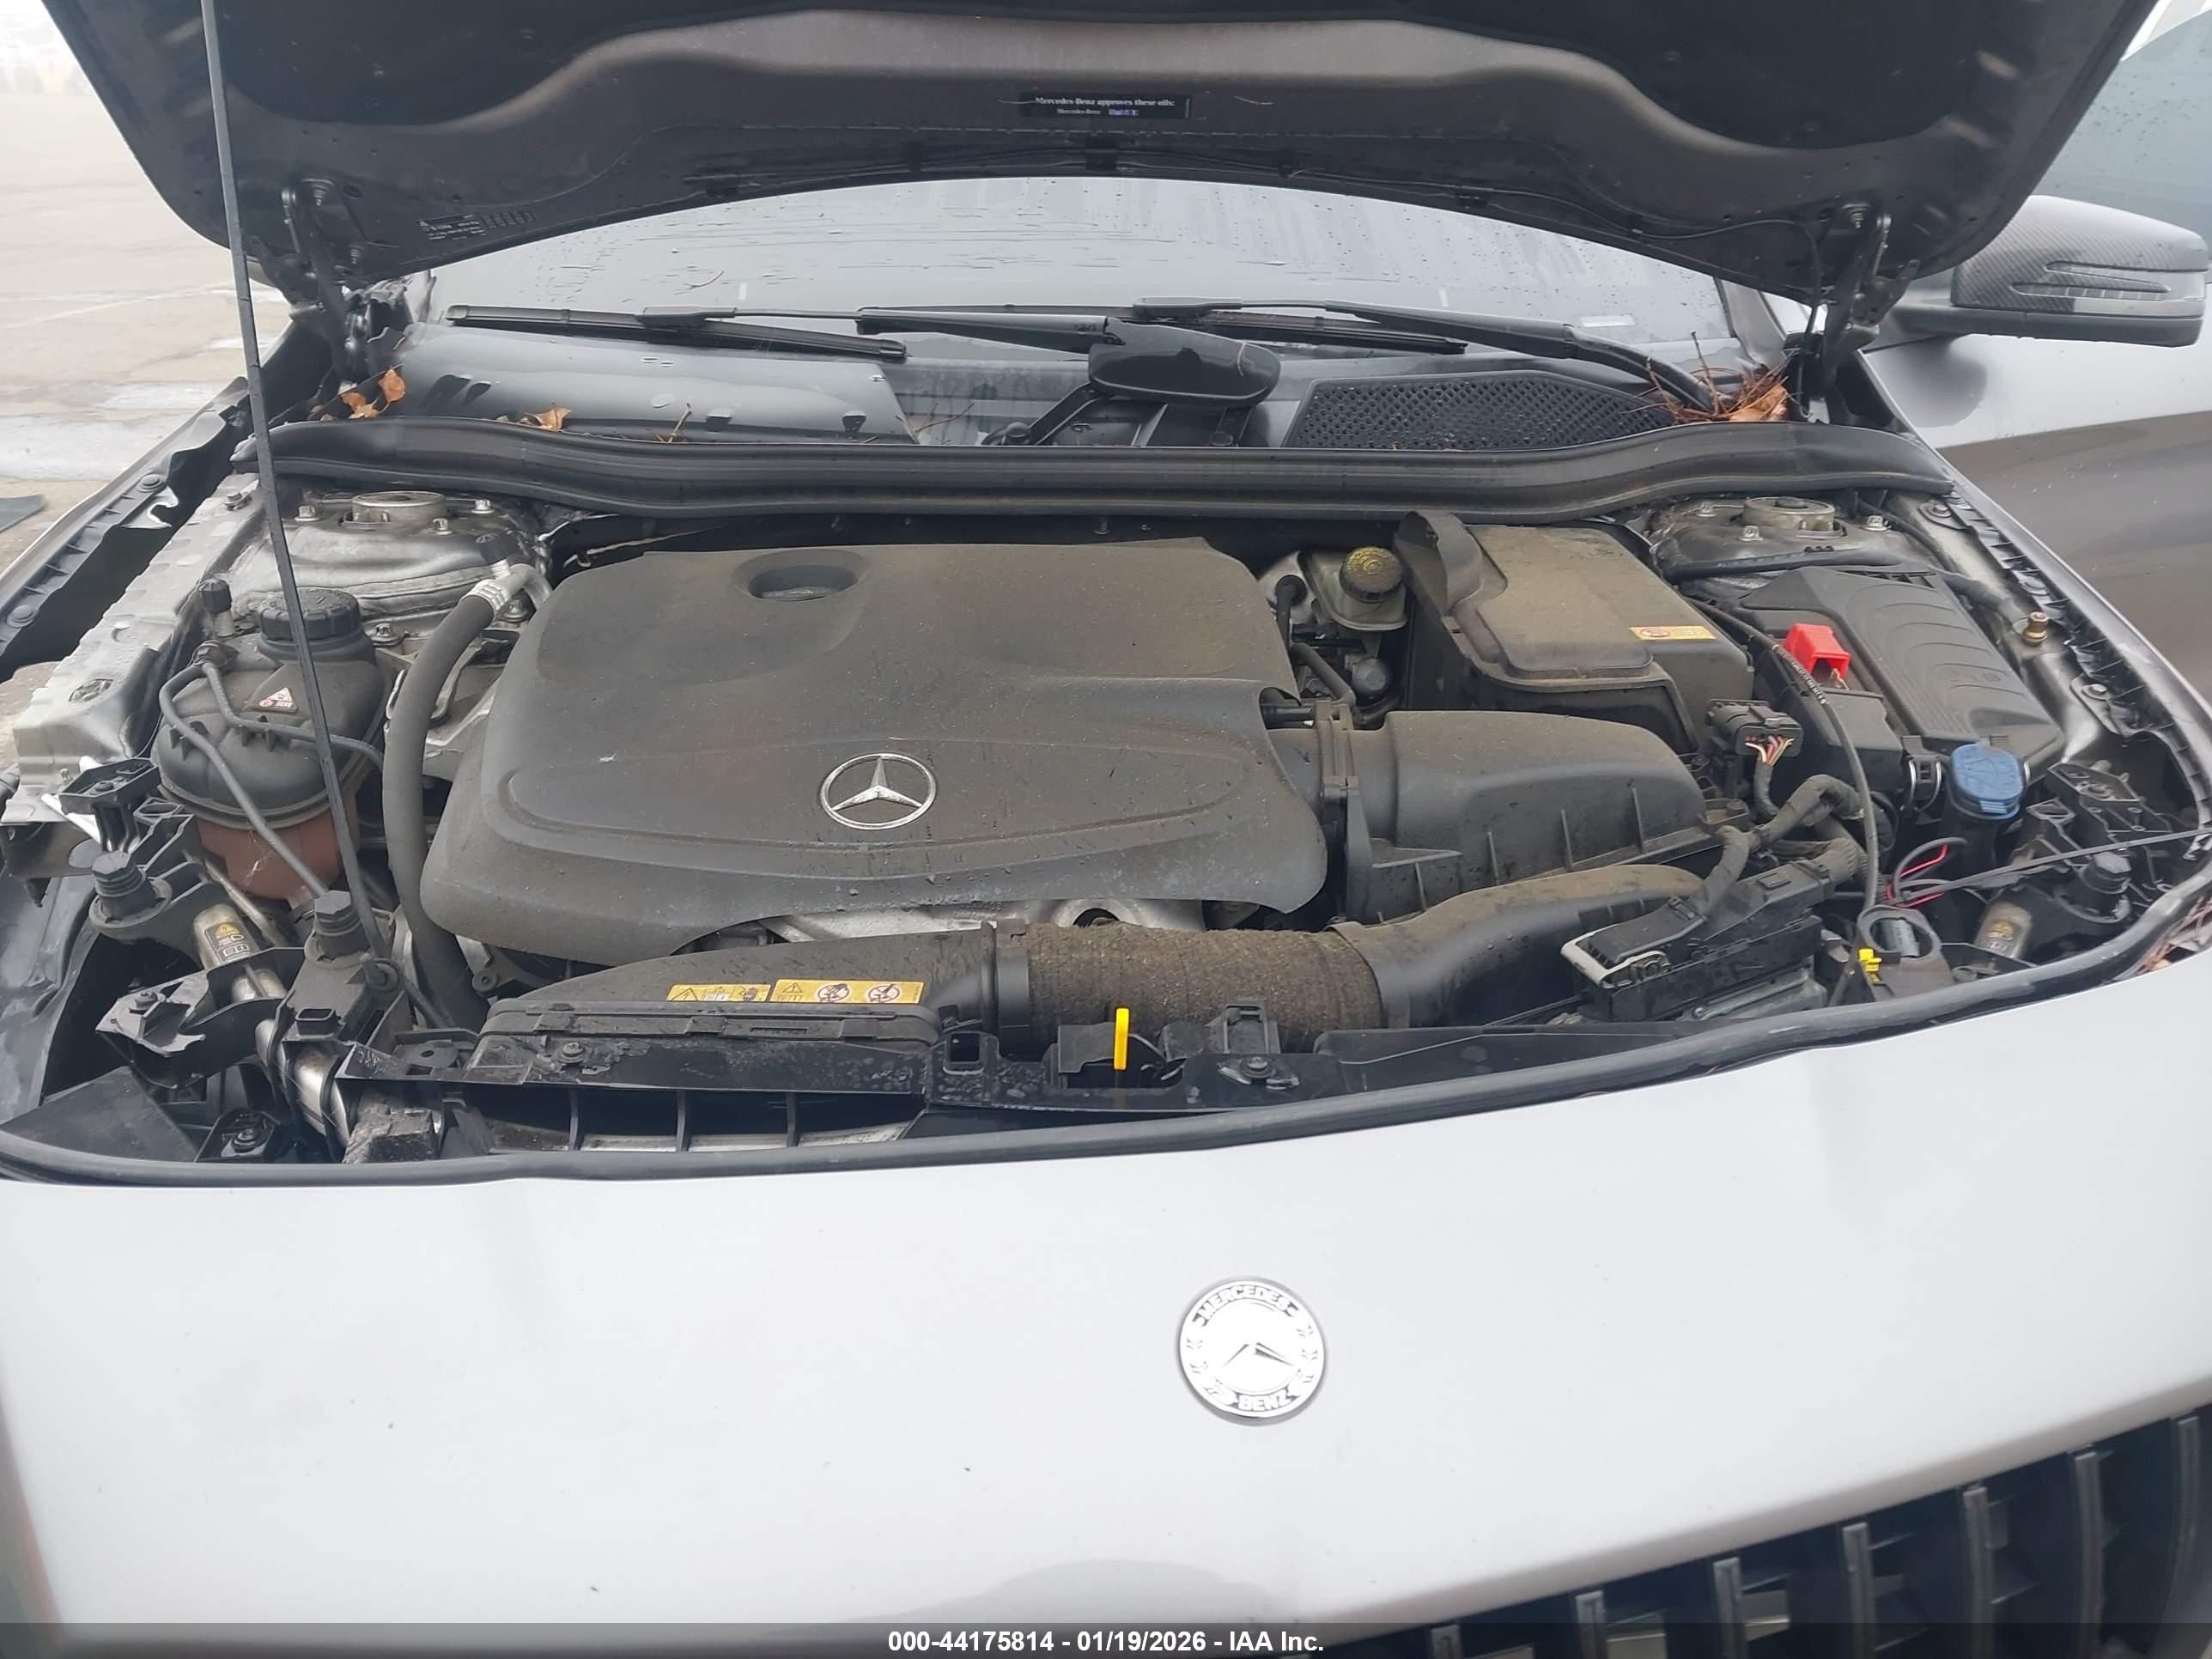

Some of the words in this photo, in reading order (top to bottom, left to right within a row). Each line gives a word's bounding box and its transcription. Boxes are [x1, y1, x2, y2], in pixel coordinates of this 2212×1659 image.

[1133, 98, 1157, 106] these
[1199, 1284, 1291, 1320] MERCEDES
[1237, 1389, 1291, 1412] BENZ
